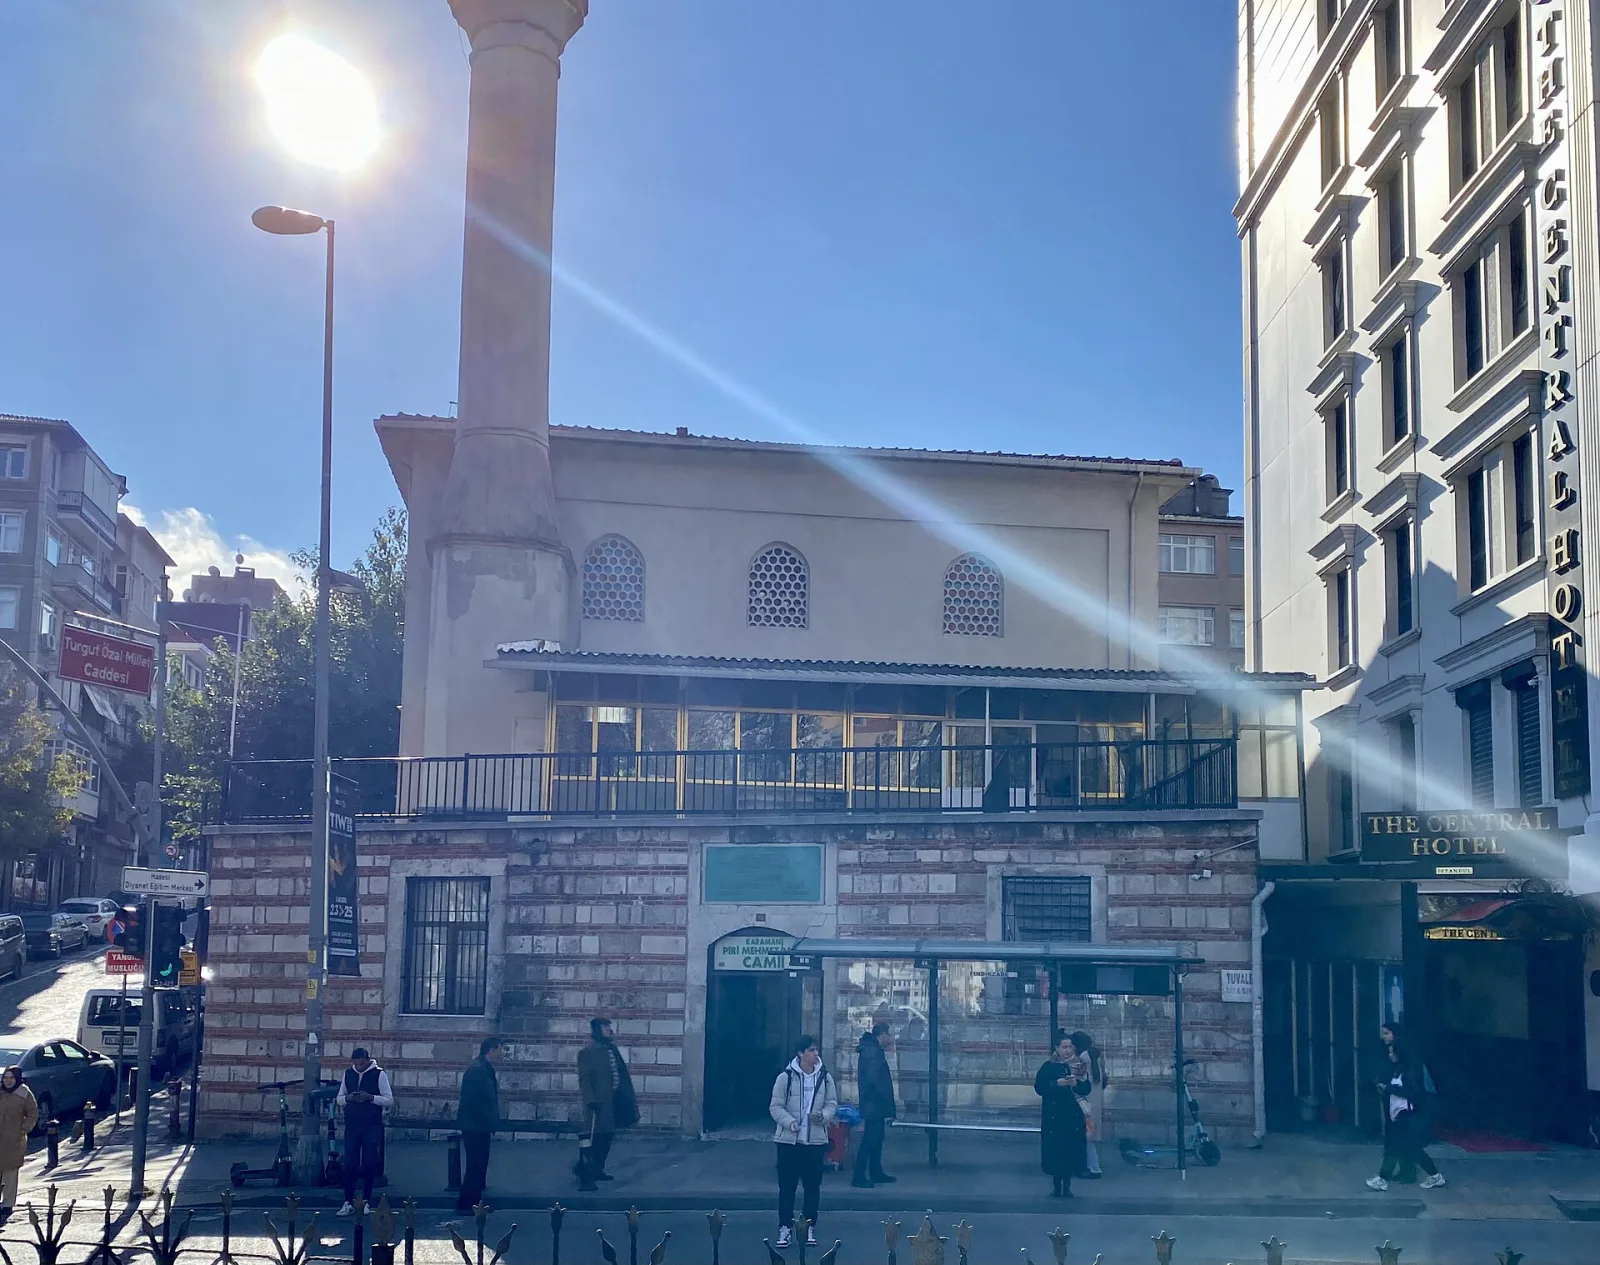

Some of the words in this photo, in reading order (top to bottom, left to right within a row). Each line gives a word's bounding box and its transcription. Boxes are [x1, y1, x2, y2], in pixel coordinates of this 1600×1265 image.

[1536, 8, 1564, 156] THE
[1541, 168, 1575, 512] CENTRAL
[65, 637, 99, 656] Turgut
[102, 642, 123, 661] Özal
[125, 652, 151, 668] Millet
[1550, 528, 1580, 791] HOTEL
[84, 663, 130, 684] Caddesi
[1368, 815, 1420, 834] THE
[1427, 812, 1550, 833] CENTRAL
[1411, 836, 1506, 856] HOTEL
[125, 881, 148, 890] Diyanet
[1442, 929, 1465, 938] THE
